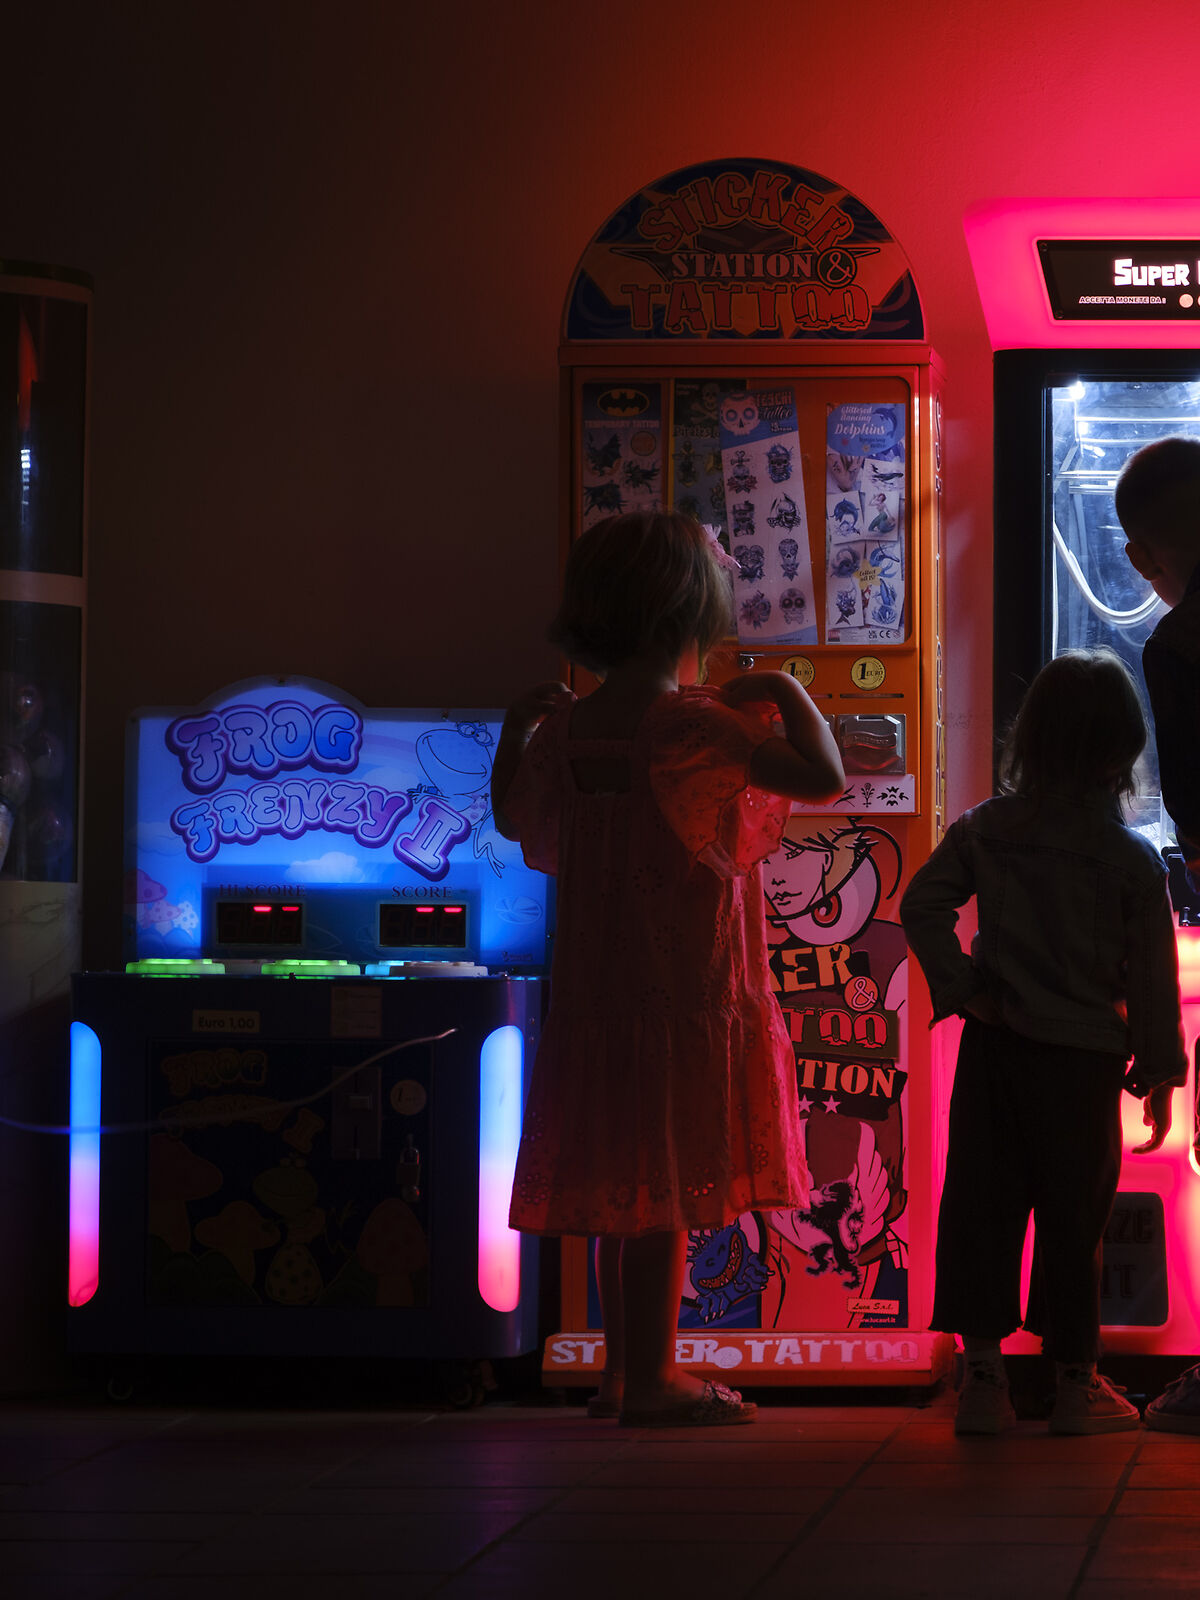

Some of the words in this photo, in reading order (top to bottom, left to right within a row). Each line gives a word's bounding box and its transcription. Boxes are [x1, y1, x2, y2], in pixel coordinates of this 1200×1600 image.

[639, 171, 854, 252] STICKER
[671, 252, 813, 278] STATION
[620, 281, 870, 331] TATTOO
[1079, 296, 1115, 304] ACCETTA
[834, 423, 886, 438] Dolphins
[166, 700, 363, 794] FROG
[171, 778, 413, 863] FRENZY
[246, 884, 305, 898] SCORE
[391, 885, 453, 899] SCORE
[198, 1016, 226, 1028] Euro
[229, 1017, 255, 1029] 1,00
[782, 1008, 888, 1049] TOO
[798, 1057, 897, 1099] TION
[744, 1339, 921, 1366] TATTOO
